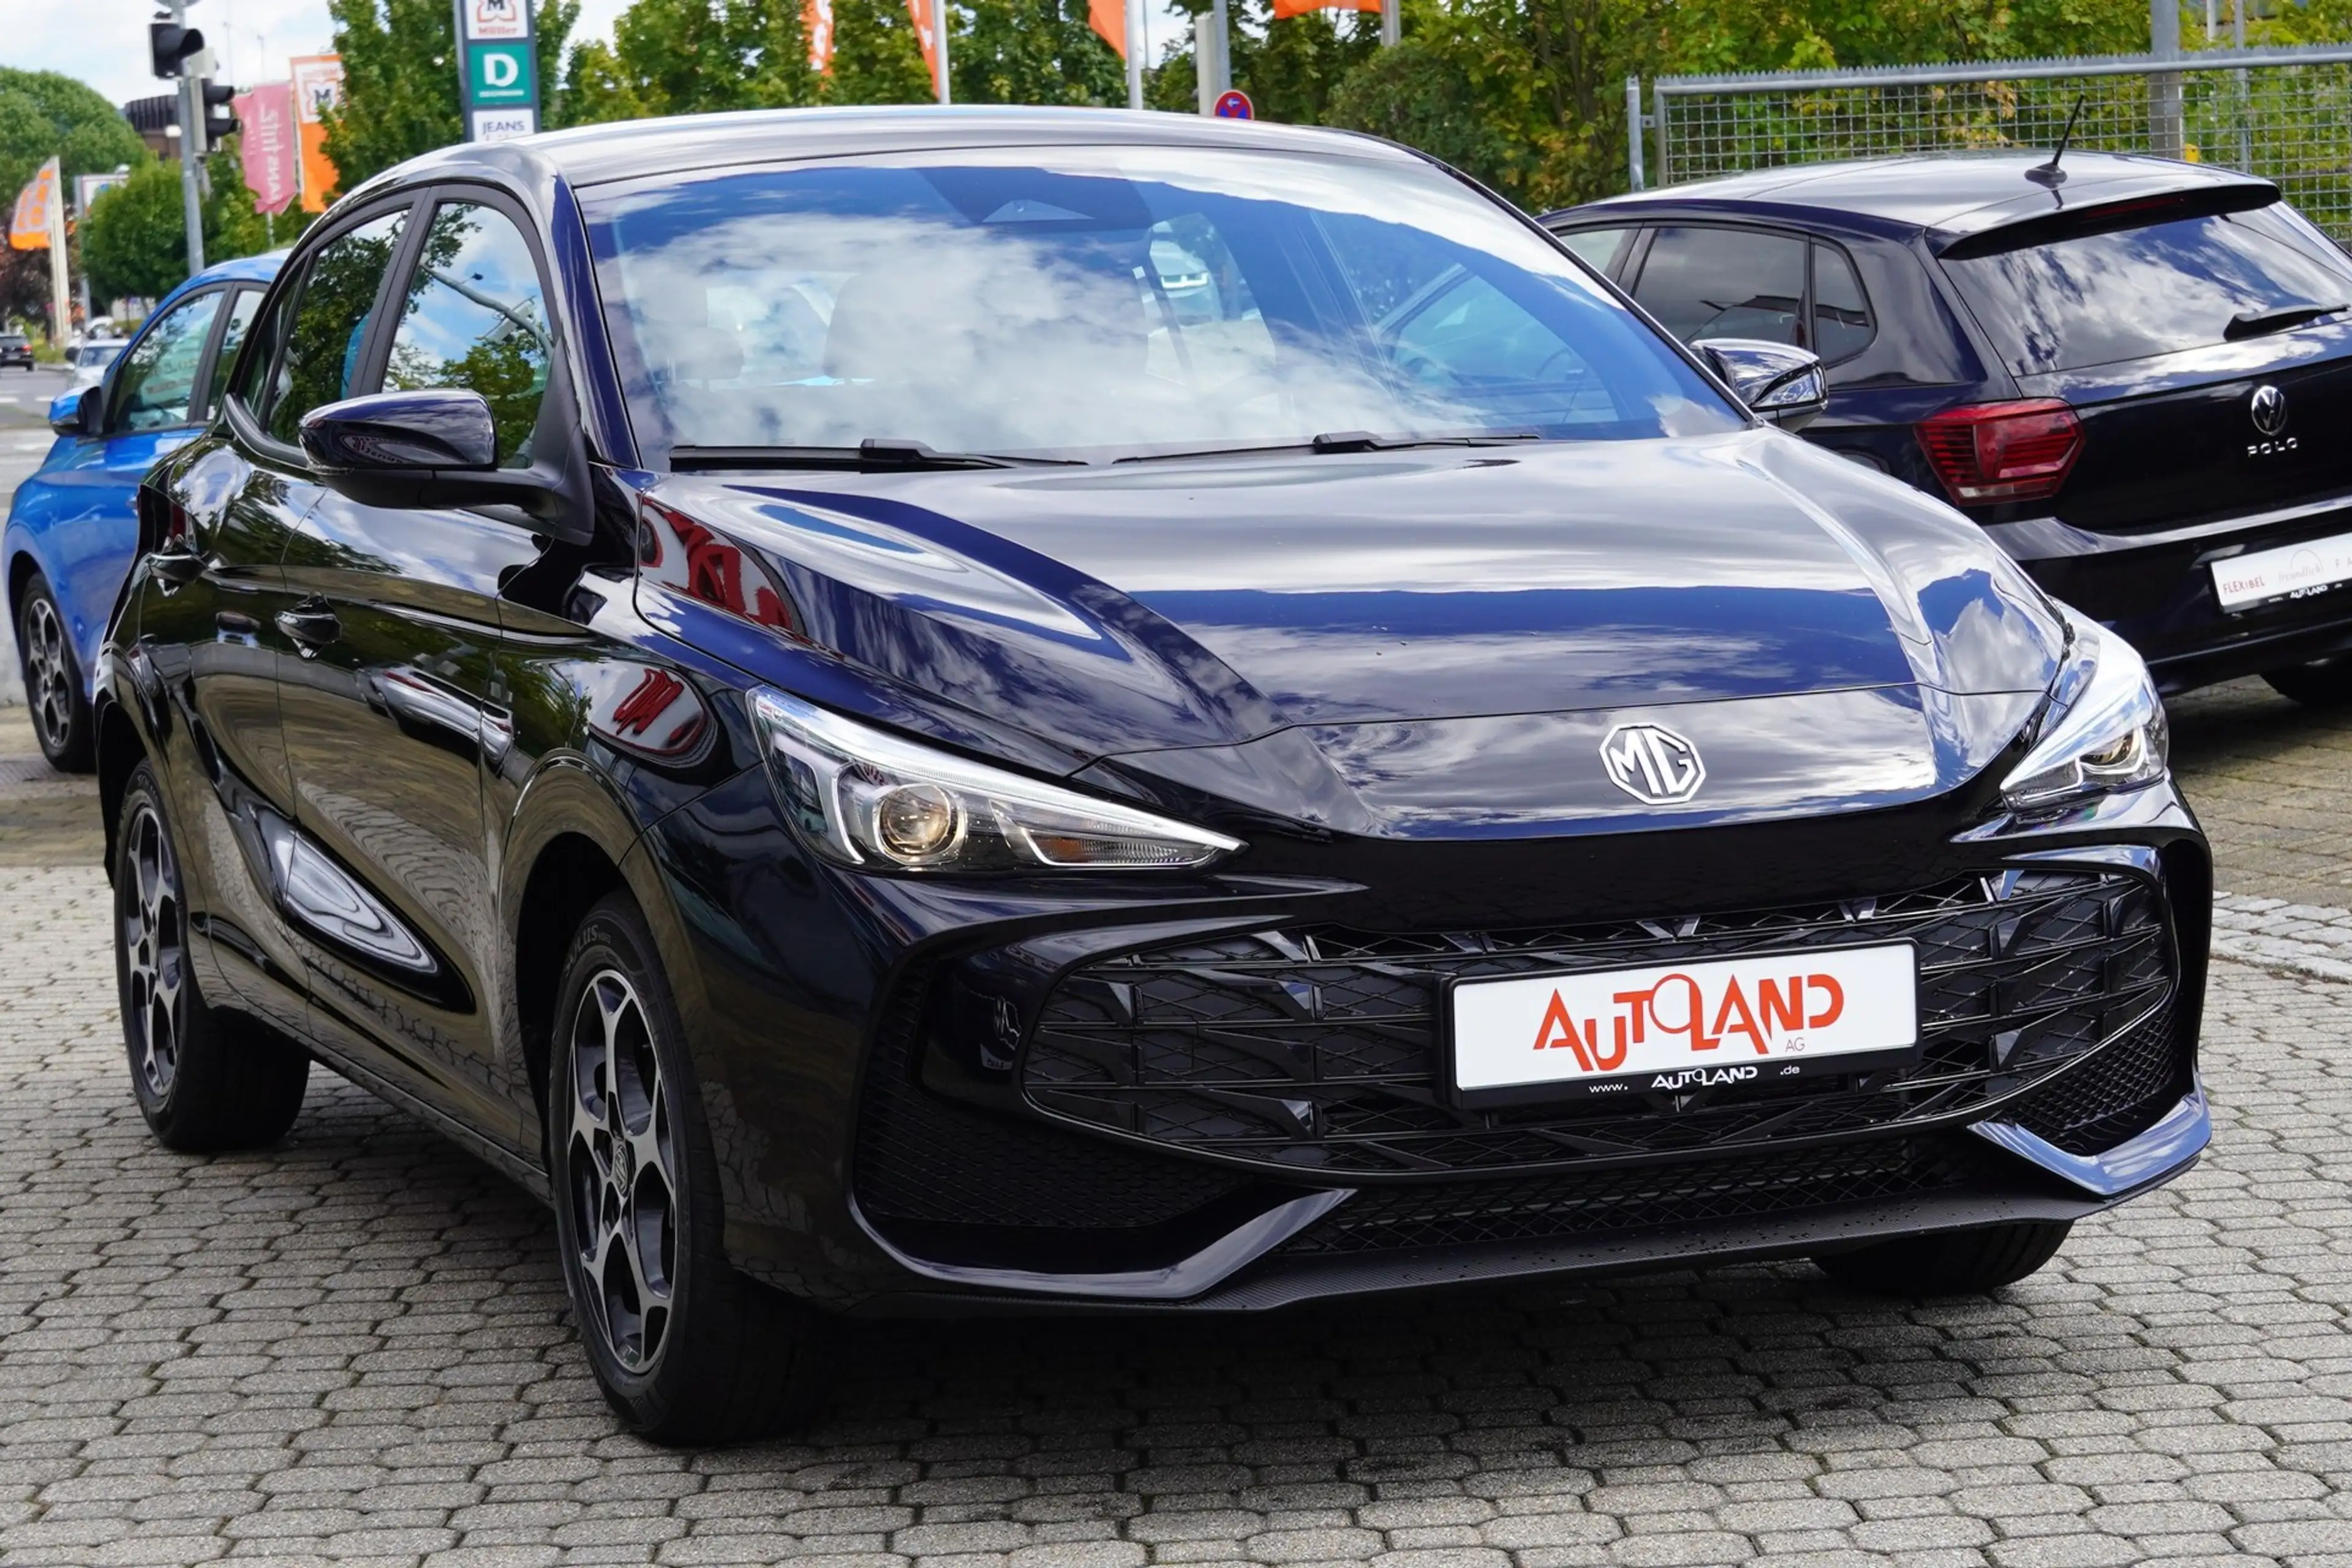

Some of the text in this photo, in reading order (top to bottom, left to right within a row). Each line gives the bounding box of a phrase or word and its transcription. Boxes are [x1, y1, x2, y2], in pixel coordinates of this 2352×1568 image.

[483, 53, 519, 87] D
[482, 121, 526, 135] JEANS
[2247, 437, 2298, 457] POLO
[1609, 729, 1697, 796] MG
[1533, 974, 1844, 1071] AUTOLAND
[1785, 1036, 1805, 1053] AG
[1589, 1065, 1800, 1093] www. AUTOLAND .de
